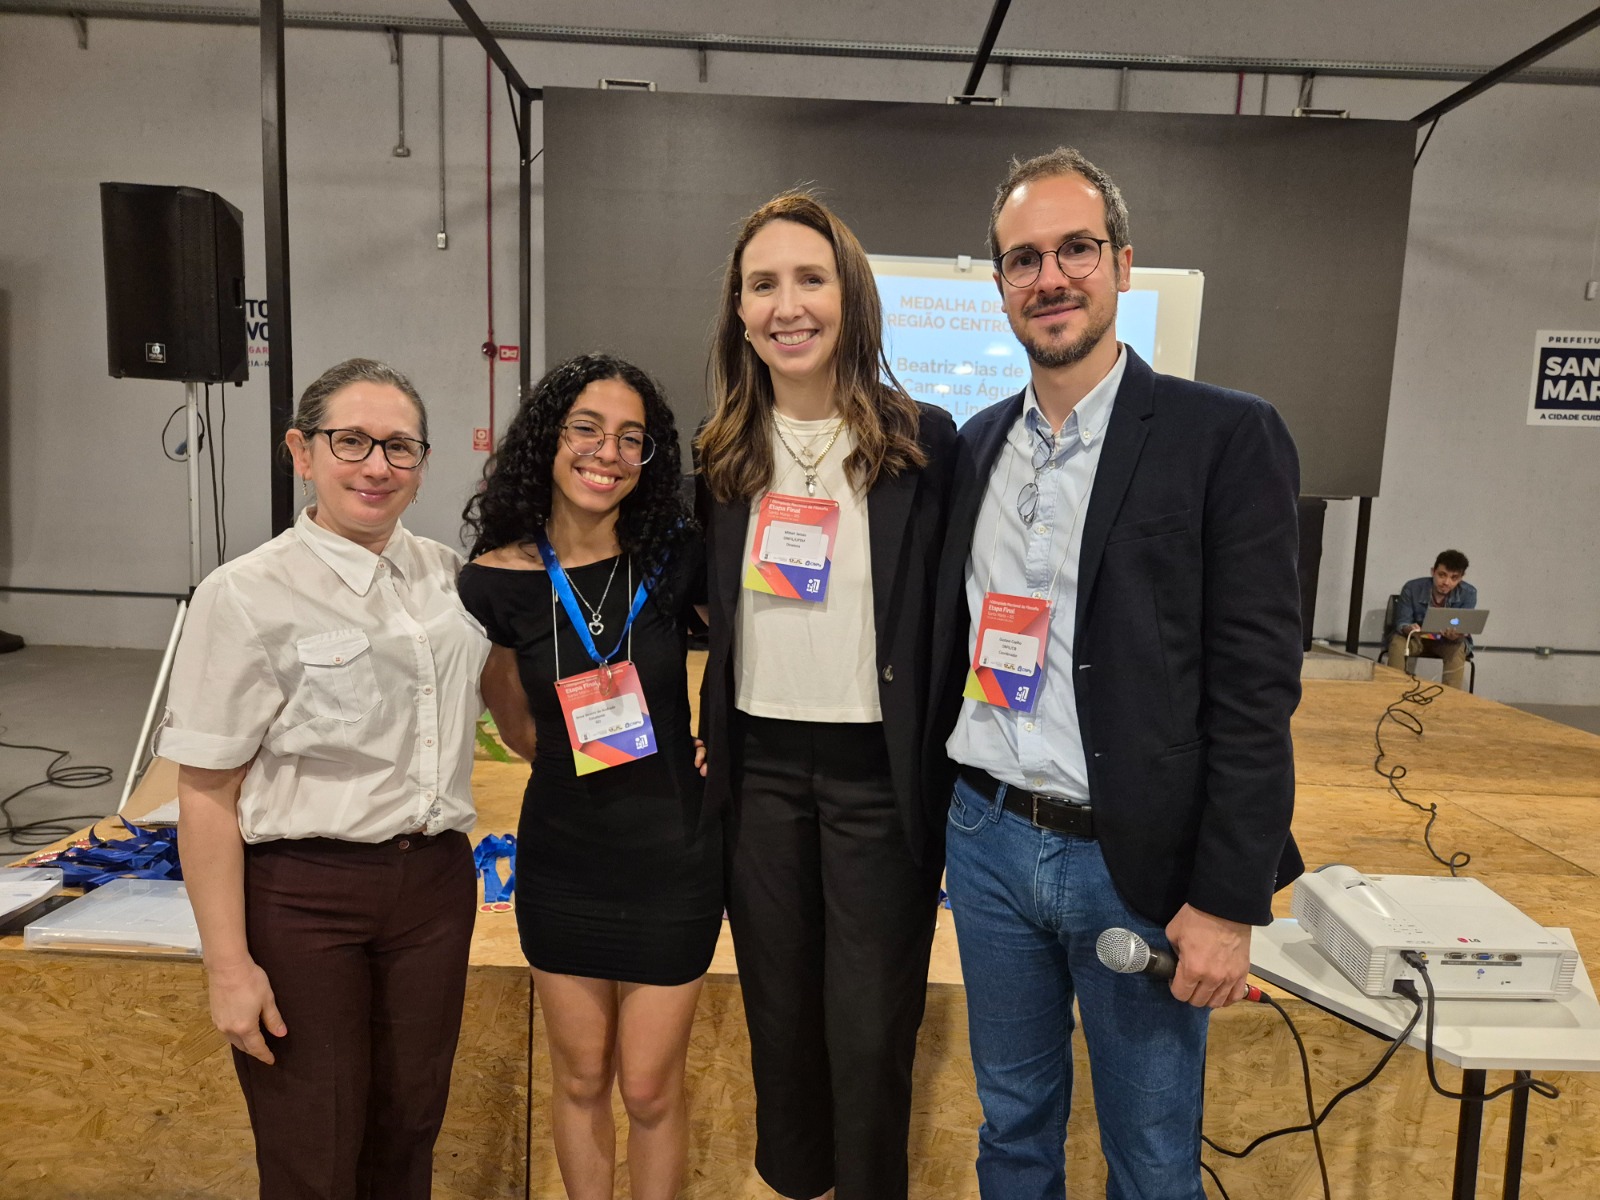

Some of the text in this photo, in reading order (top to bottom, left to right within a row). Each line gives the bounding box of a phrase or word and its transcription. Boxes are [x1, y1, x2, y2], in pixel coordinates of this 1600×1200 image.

[901, 296, 1002, 314] MEDALHA DE
[887, 312, 946, 329] REGIÃO
[897, 358, 957, 375] Beatriz
[1003, 364, 1024, 378] de
[1544, 356, 1600, 377] SAN
[902, 378, 971, 398] Campus
[1548, 413, 1579, 421] CIDADE
[768, 503, 801, 514] Etapa Final
[988, 604, 1015, 614] Etapa Final
